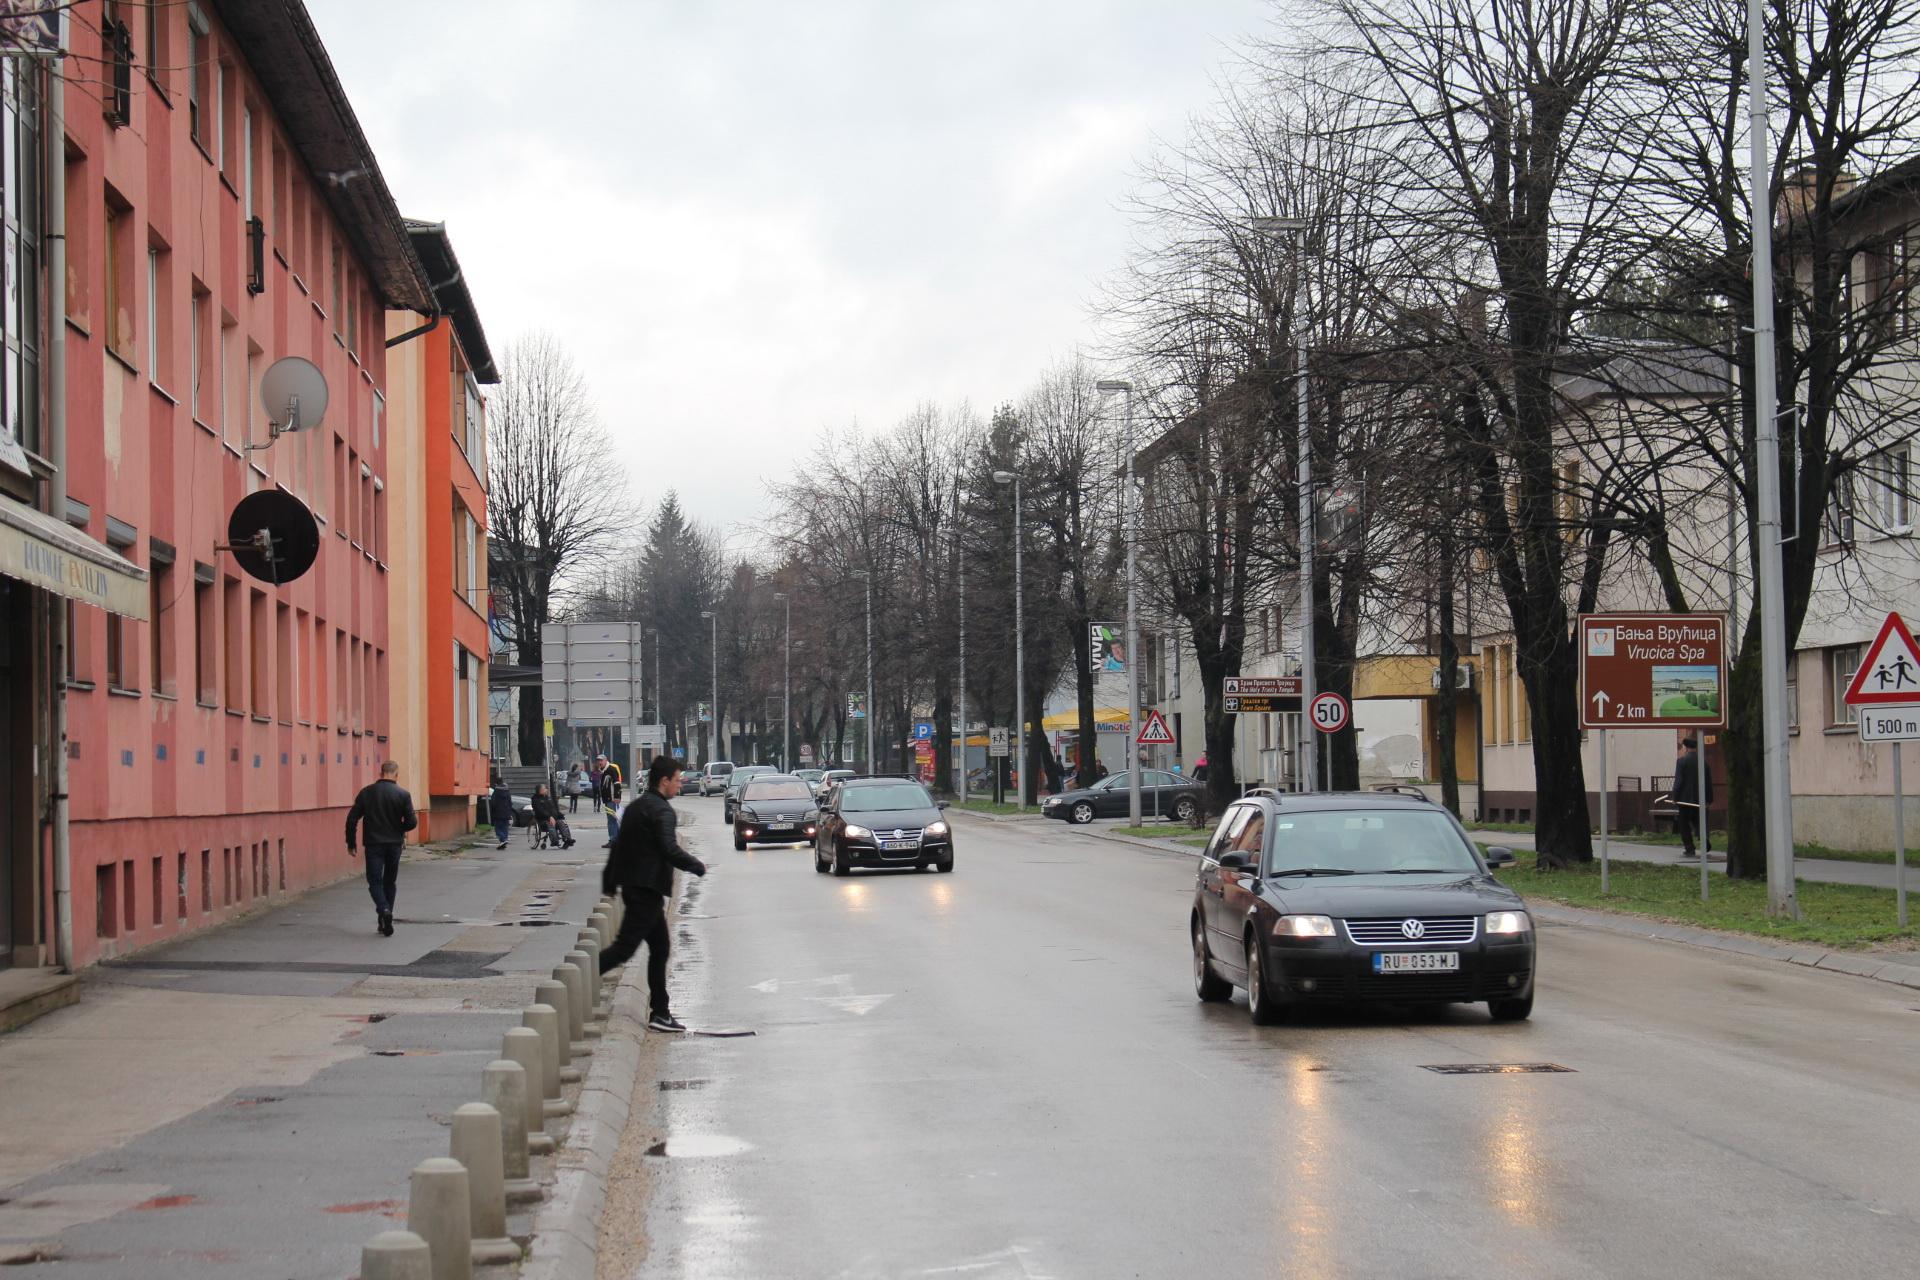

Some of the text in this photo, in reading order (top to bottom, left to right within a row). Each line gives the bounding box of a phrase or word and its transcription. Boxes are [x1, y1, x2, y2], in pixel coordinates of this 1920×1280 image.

[1616, 625, 1716, 644] Бања Врућица
[1628, 644, 1706, 662] Vrucica Spa
[1318, 703, 1340, 722] 50
[1616, 704, 1645, 718] 2 km
[1878, 719, 1916, 734] 500 m
